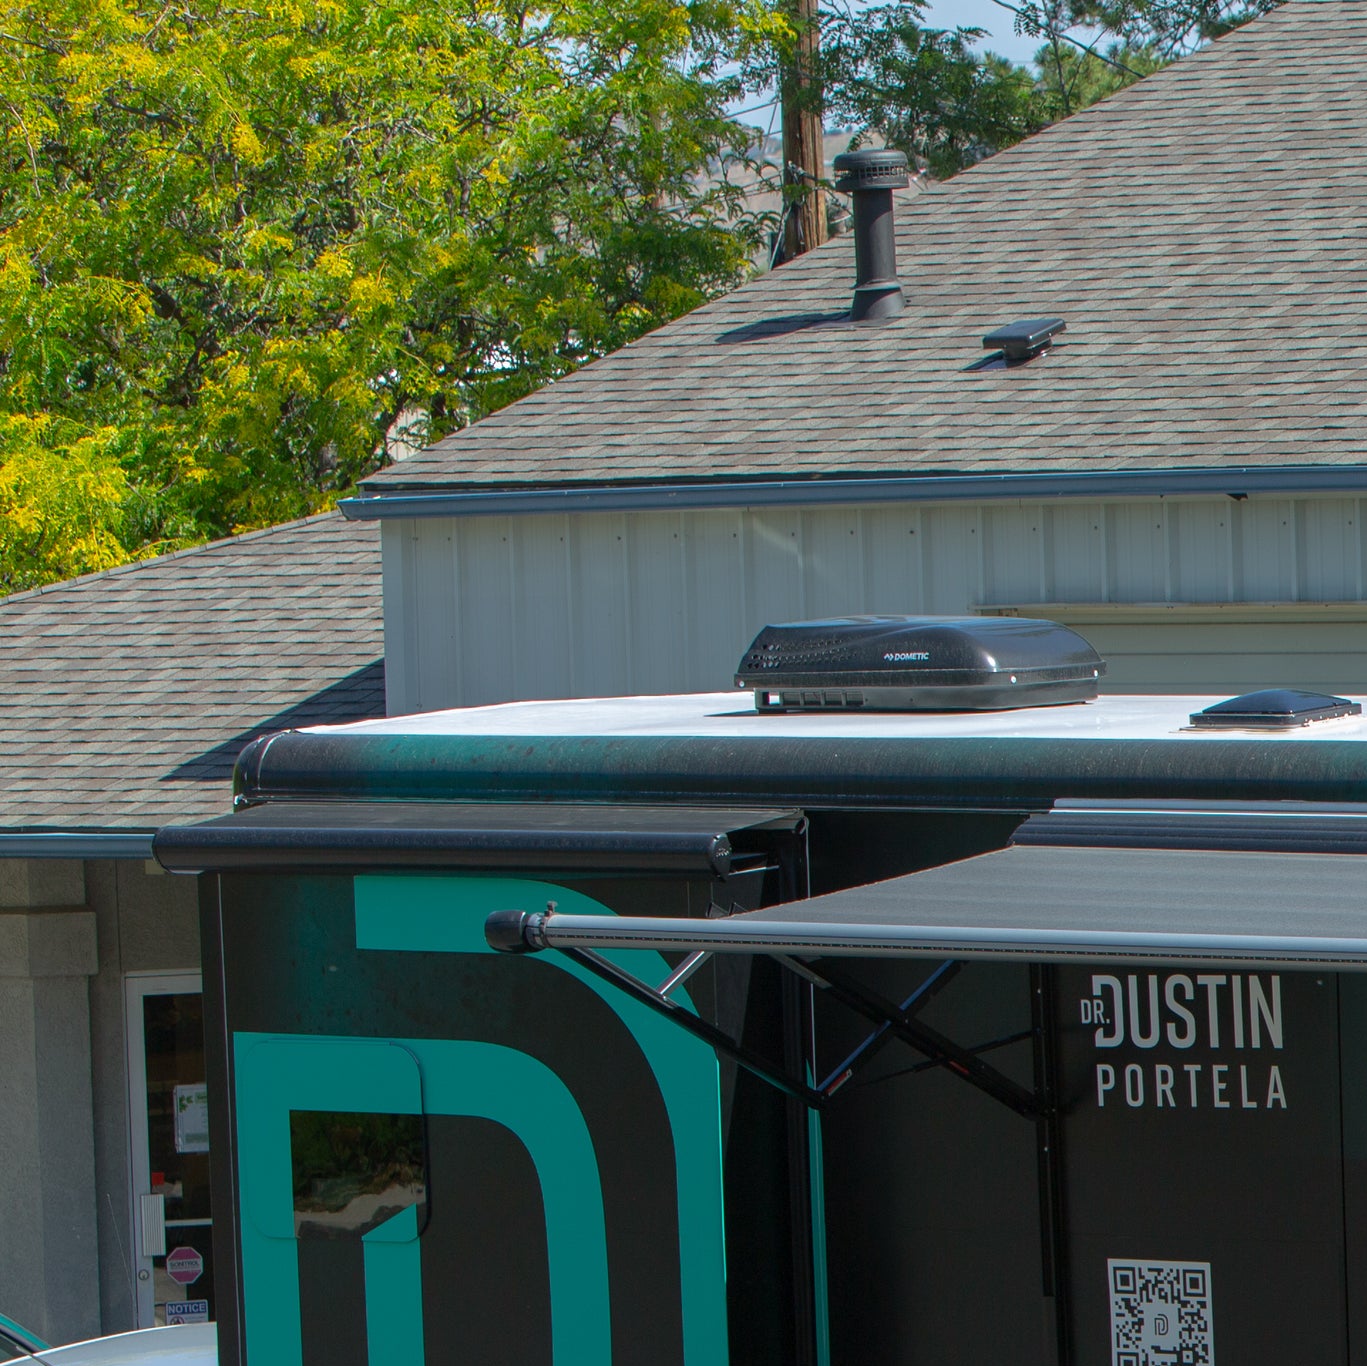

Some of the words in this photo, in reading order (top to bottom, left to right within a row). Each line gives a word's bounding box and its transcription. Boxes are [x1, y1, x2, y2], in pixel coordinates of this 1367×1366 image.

[894, 652, 929, 661] DOMETIC
[1080, 999, 1111, 1024] DR.
[1092, 974, 1283, 1049] DUSTIN
[1096, 1063, 1287, 1109] PORTELA
[168, 1303, 206, 1314] NOTICE
